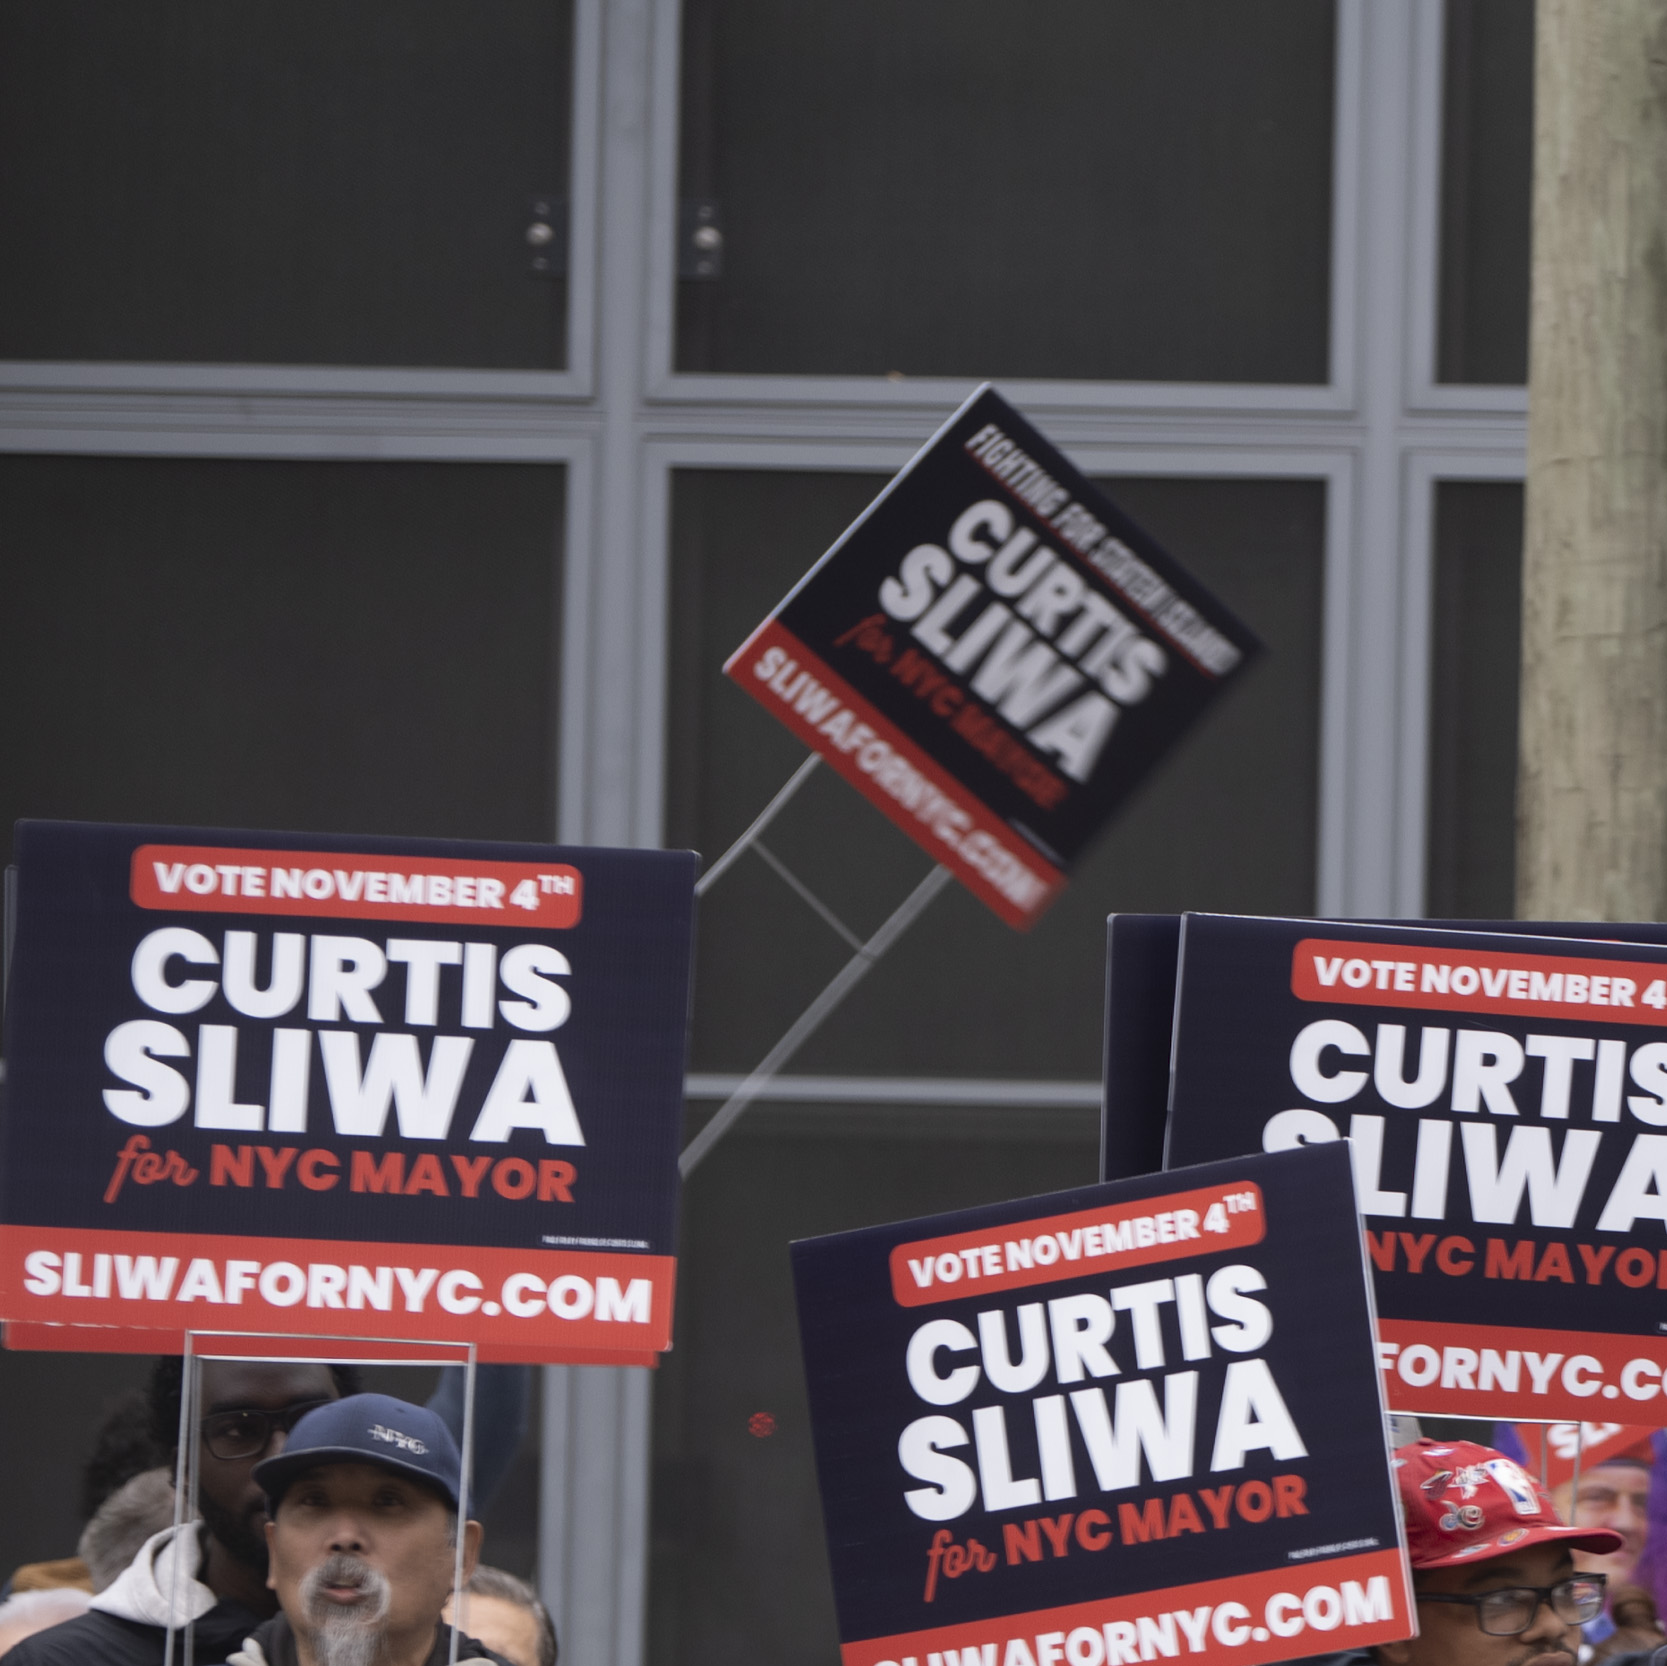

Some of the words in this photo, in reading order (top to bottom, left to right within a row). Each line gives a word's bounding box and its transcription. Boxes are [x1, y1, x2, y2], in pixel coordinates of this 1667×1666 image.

[965, 423, 1070, 517] FIGHTING
[948, 500, 1169, 705] CURTIS
[878, 543, 1121, 784] SLIWA
[153, 861, 267, 898] VOTE
[270, 866, 503, 909] NOVEMBER
[508, 874, 574, 912] 4TH
[131, 927, 573, 1032] CURTIS
[1313, 955, 1415, 994] VOTE
[1420, 961, 1632, 1009] NOVEMBER
[102, 1019, 586, 1147] SLIWA
[104, 1135, 199, 1204] for
[209, 1144, 340, 1192] NYC
[350, 1149, 579, 1203] MAYOR
[23, 1250, 652, 1324] SLIWAFORNYC.COM
[907, 1243, 1003, 1288] VOTE
[1005, 1210, 1200, 1271] NOVEMBER
[1204, 1192, 1257, 1234] 4TH
[905, 1264, 1275, 1407] CURTIS
[898, 1358, 1310, 1522] SLIWA
[923, 1528, 998, 1602] for
[1003, 1509, 1112, 1567] NYC
[1119, 1474, 1311, 1546] MAYOR
